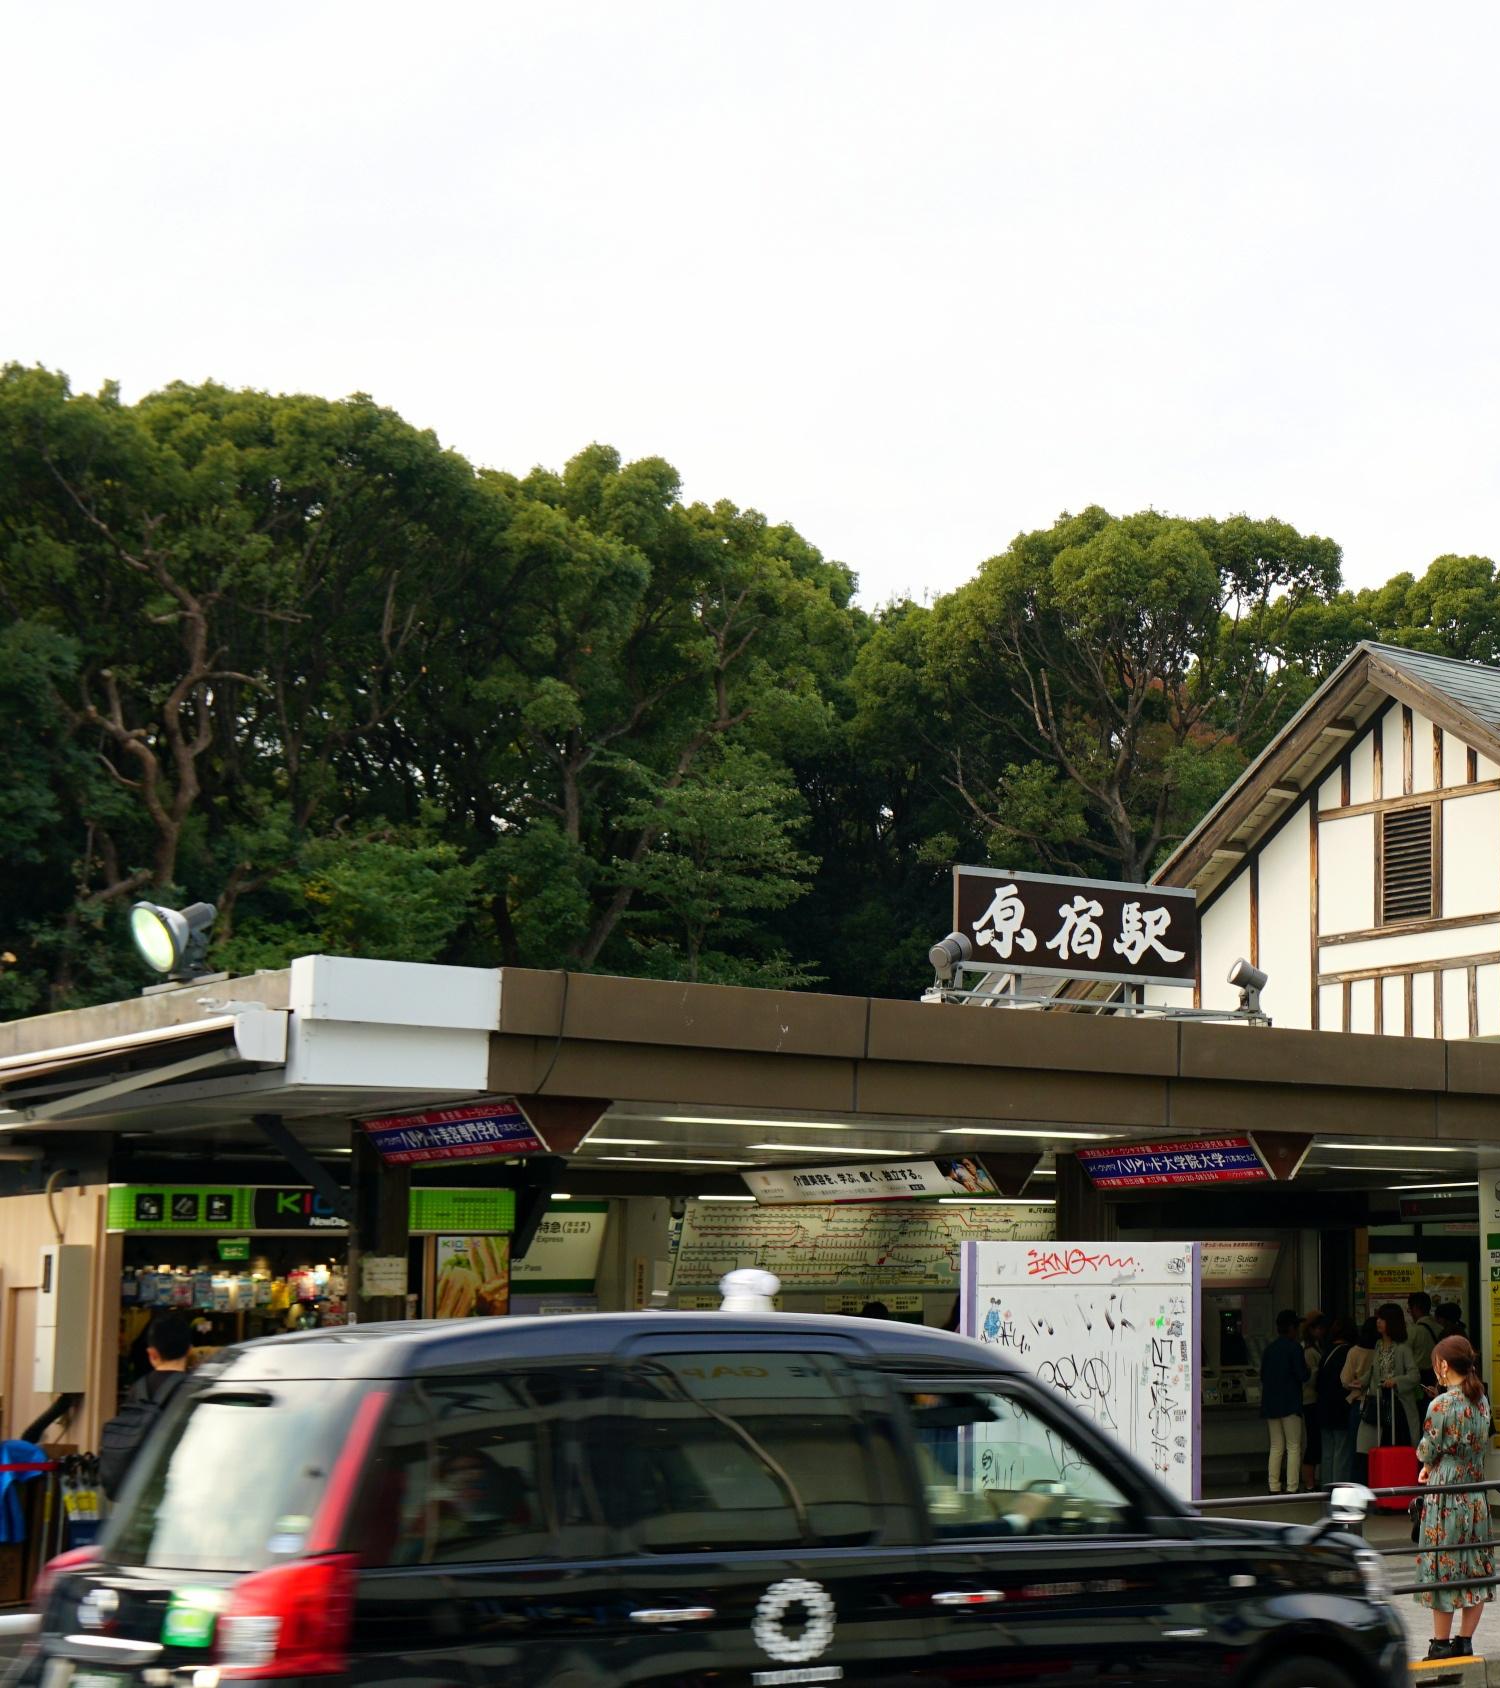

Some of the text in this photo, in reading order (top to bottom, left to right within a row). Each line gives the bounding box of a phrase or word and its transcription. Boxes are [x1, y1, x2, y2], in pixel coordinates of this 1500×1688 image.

[972, 883, 1186, 965] 原宿駅
[1117, 1152, 1226, 1174] ハリウッド大学院大学
[536, 1235, 565, 1244] Express
[1236, 1255, 1258, 1263] Suica
